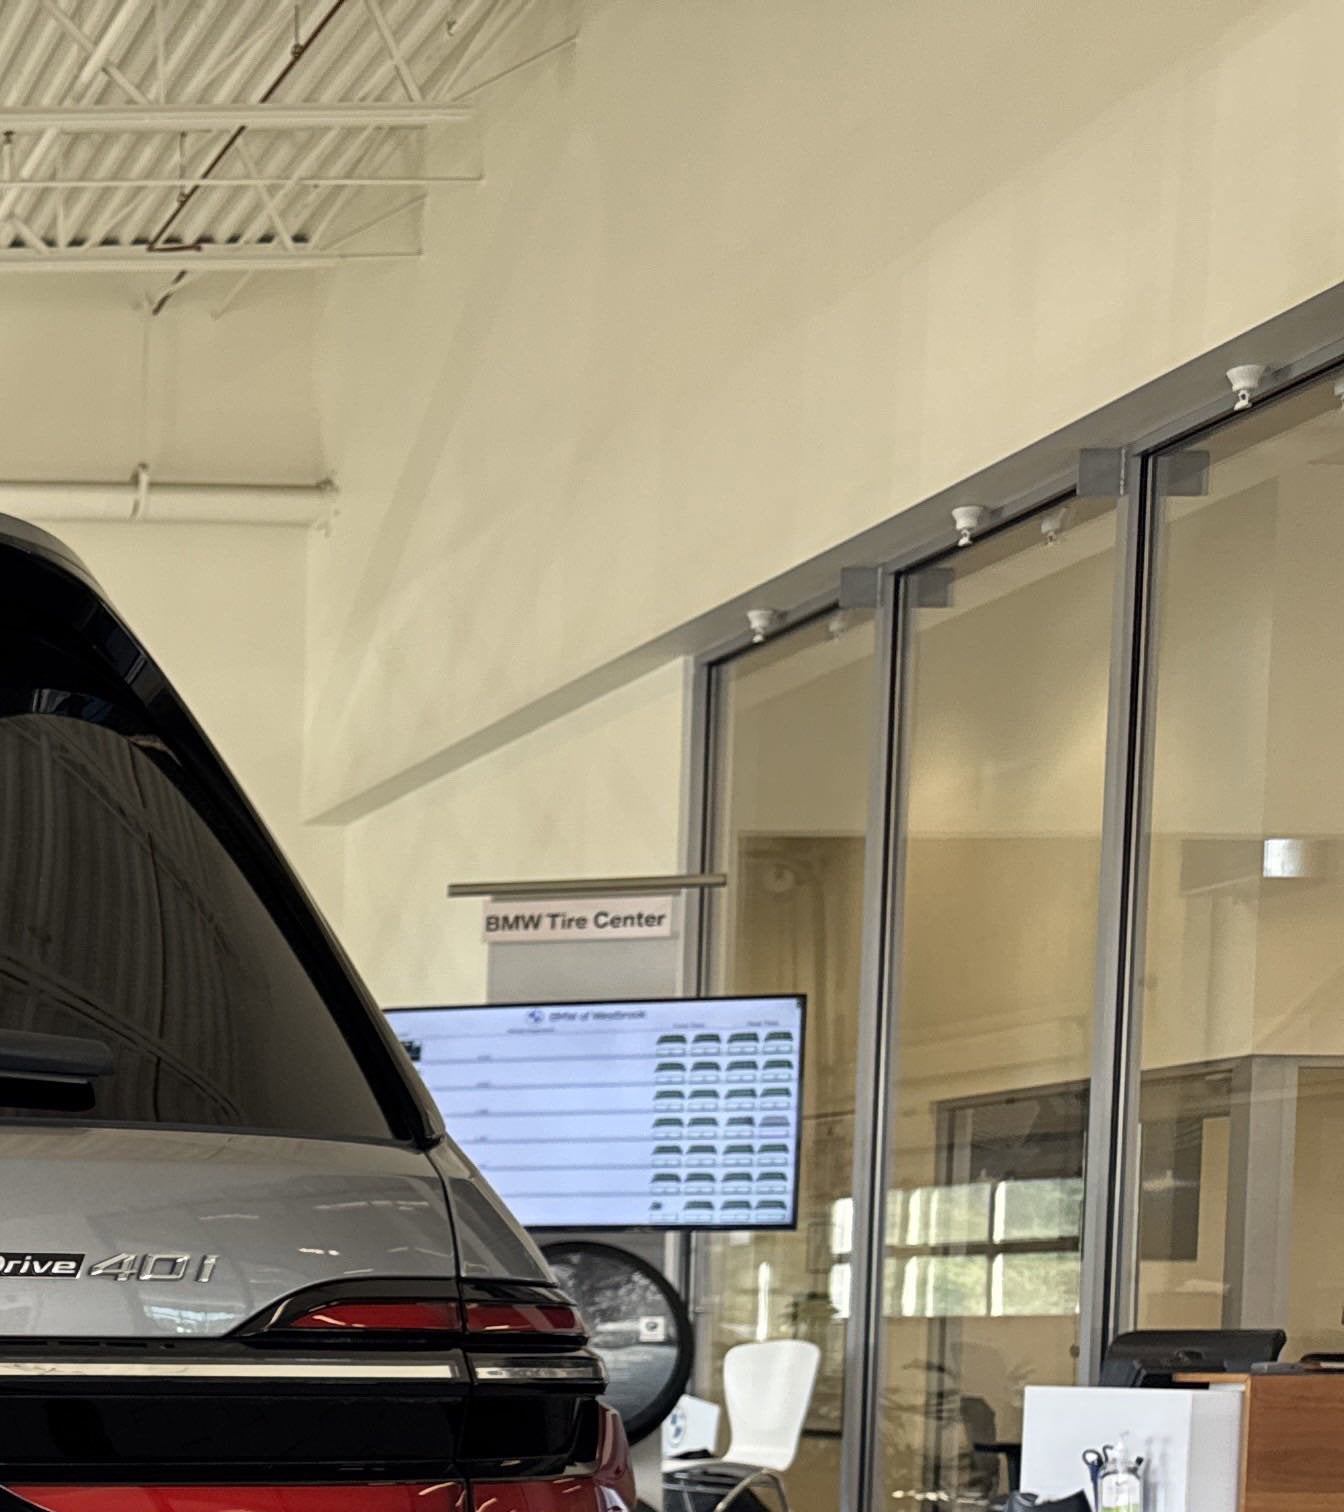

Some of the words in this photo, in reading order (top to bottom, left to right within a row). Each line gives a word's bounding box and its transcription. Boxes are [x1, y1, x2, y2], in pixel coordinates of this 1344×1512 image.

[484, 913, 543, 933] BMW
[546, 911, 588, 931] Tire
[593, 910, 667, 930] Center
